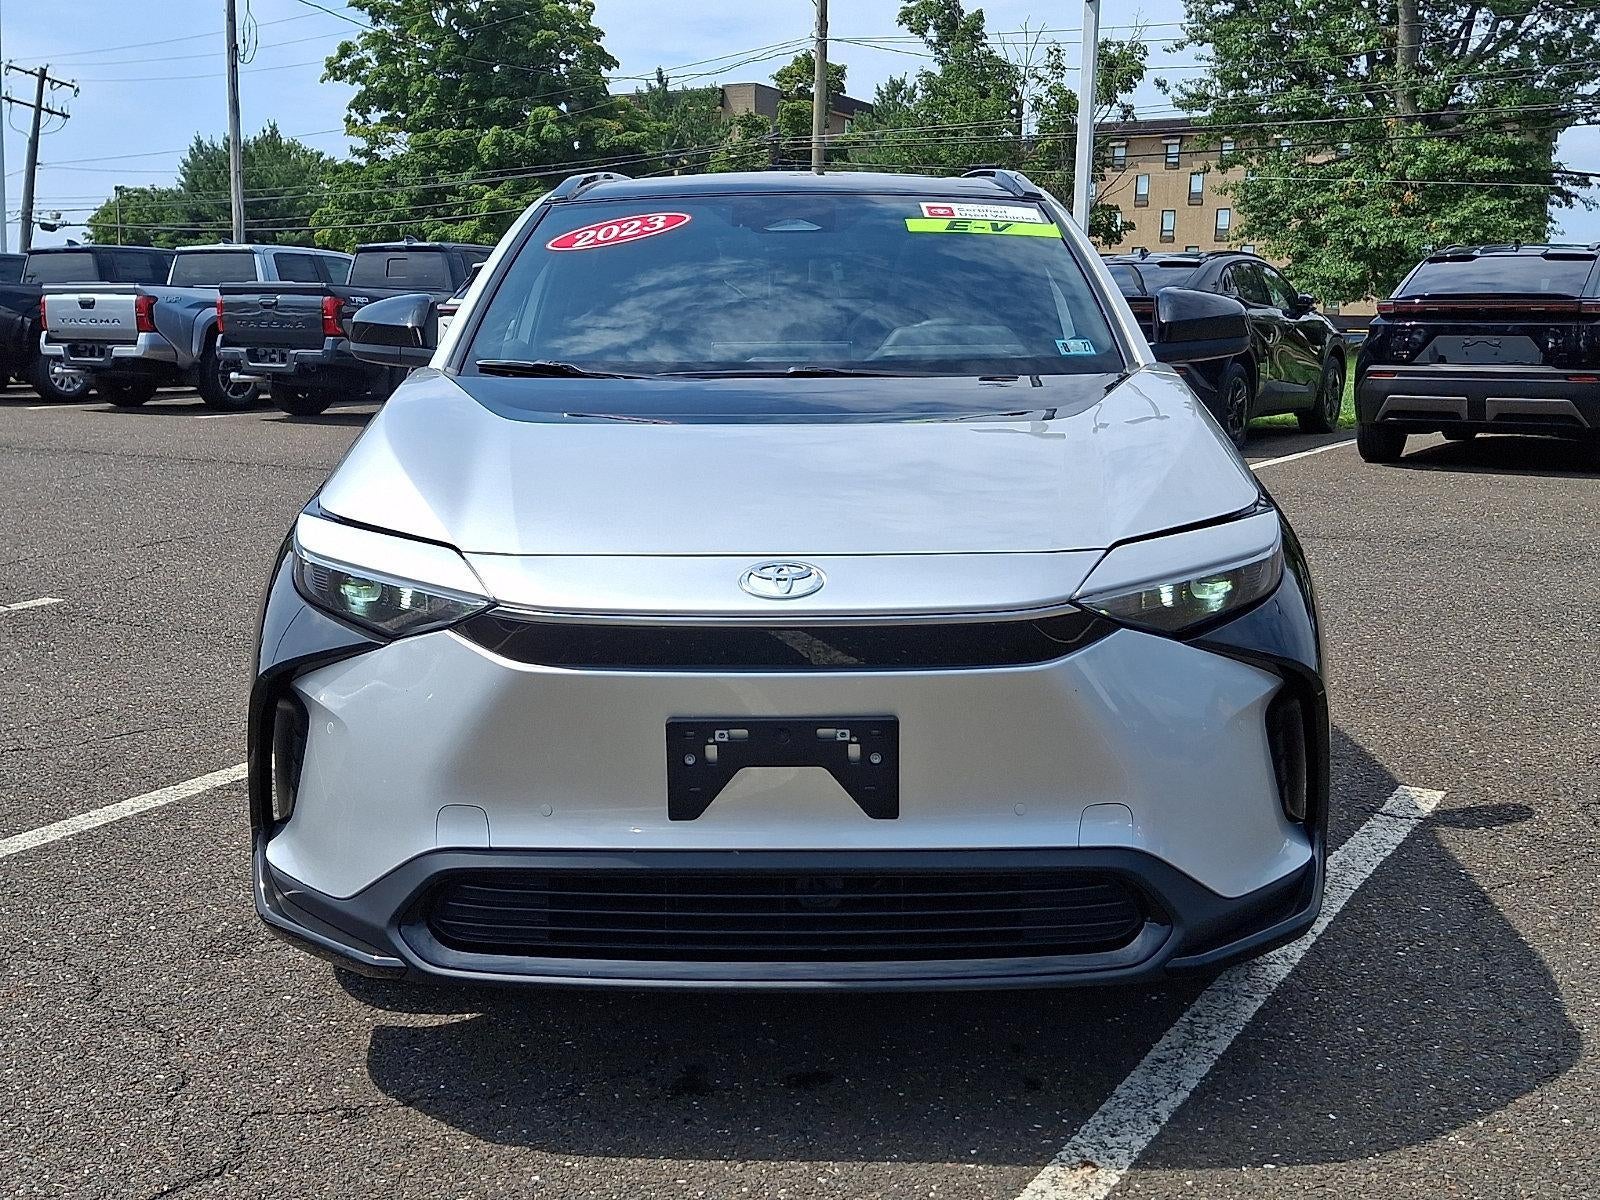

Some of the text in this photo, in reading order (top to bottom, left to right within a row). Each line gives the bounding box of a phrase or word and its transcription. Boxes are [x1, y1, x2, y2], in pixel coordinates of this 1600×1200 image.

[571, 215, 668, 248] 2023
[944, 220, 1014, 232] E-V
[236, 320, 306, 329] TACOMA
